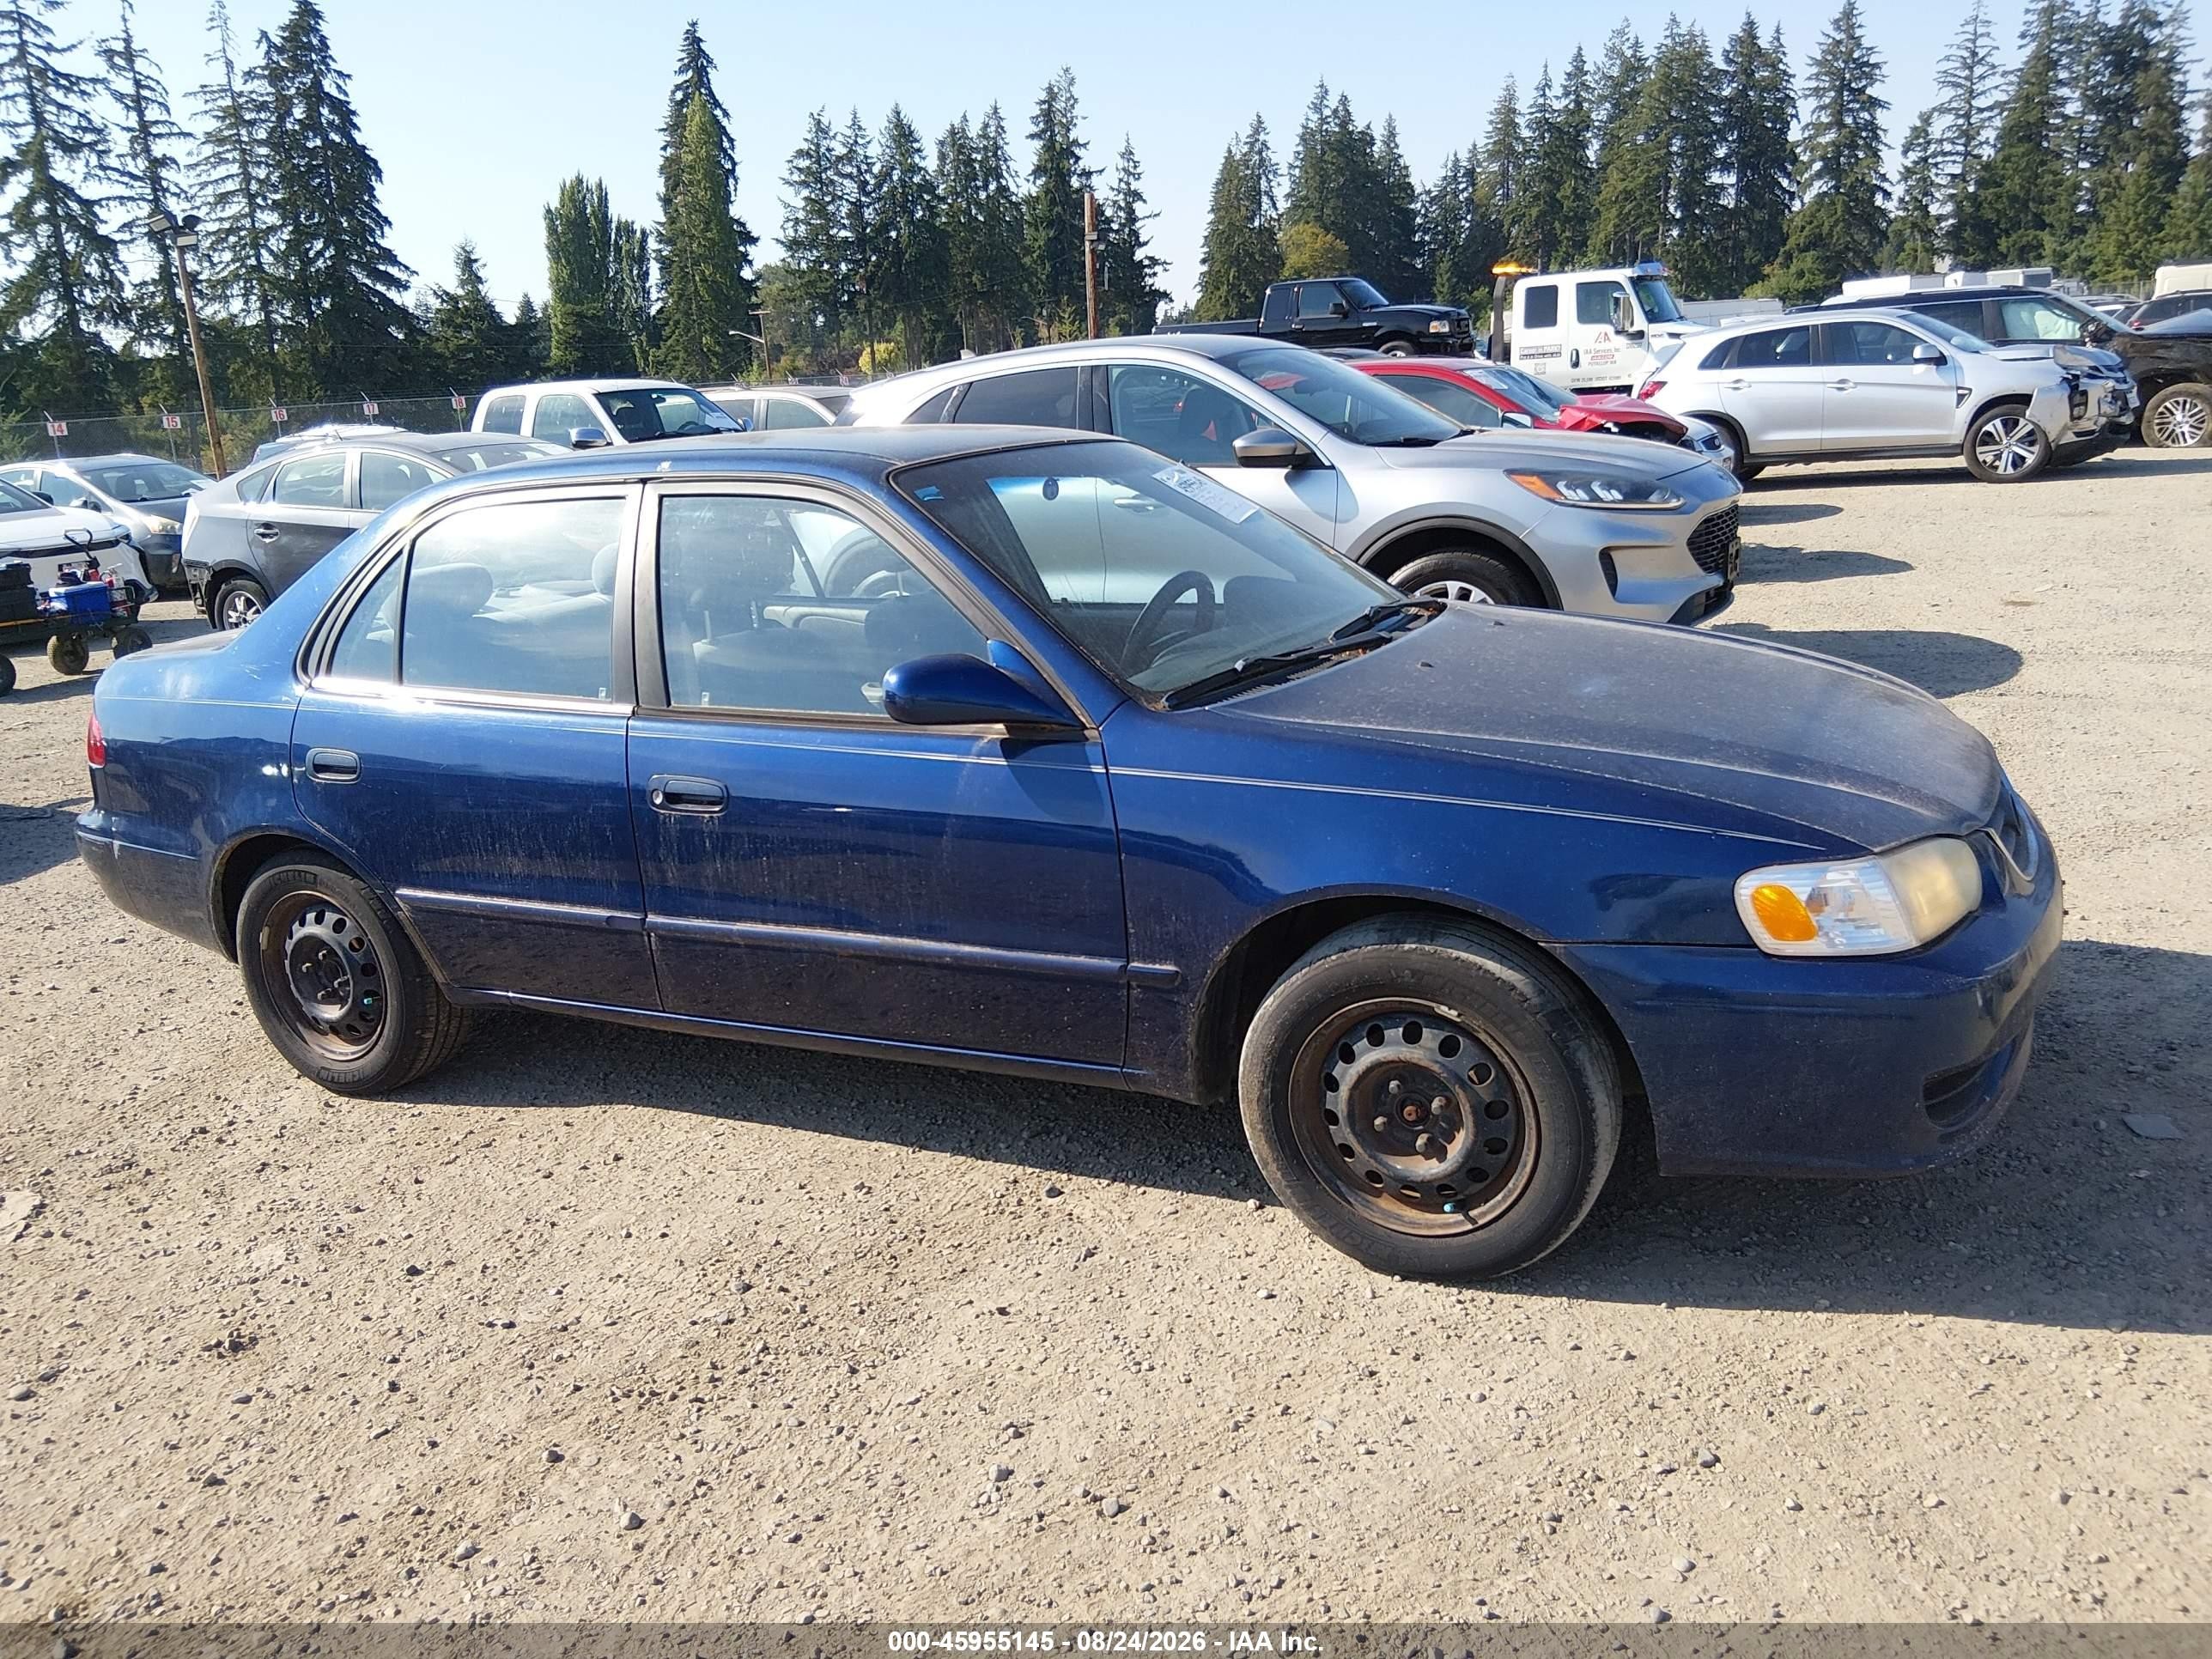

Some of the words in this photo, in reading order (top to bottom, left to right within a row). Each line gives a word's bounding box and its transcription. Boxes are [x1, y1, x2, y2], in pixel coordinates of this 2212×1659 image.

[454, 398, 465, 408] 18
[366, 404, 375, 413] 17
[273, 410, 285, 420] 16
[166, 416, 179, 428] 15
[50, 424, 64, 434] 14
